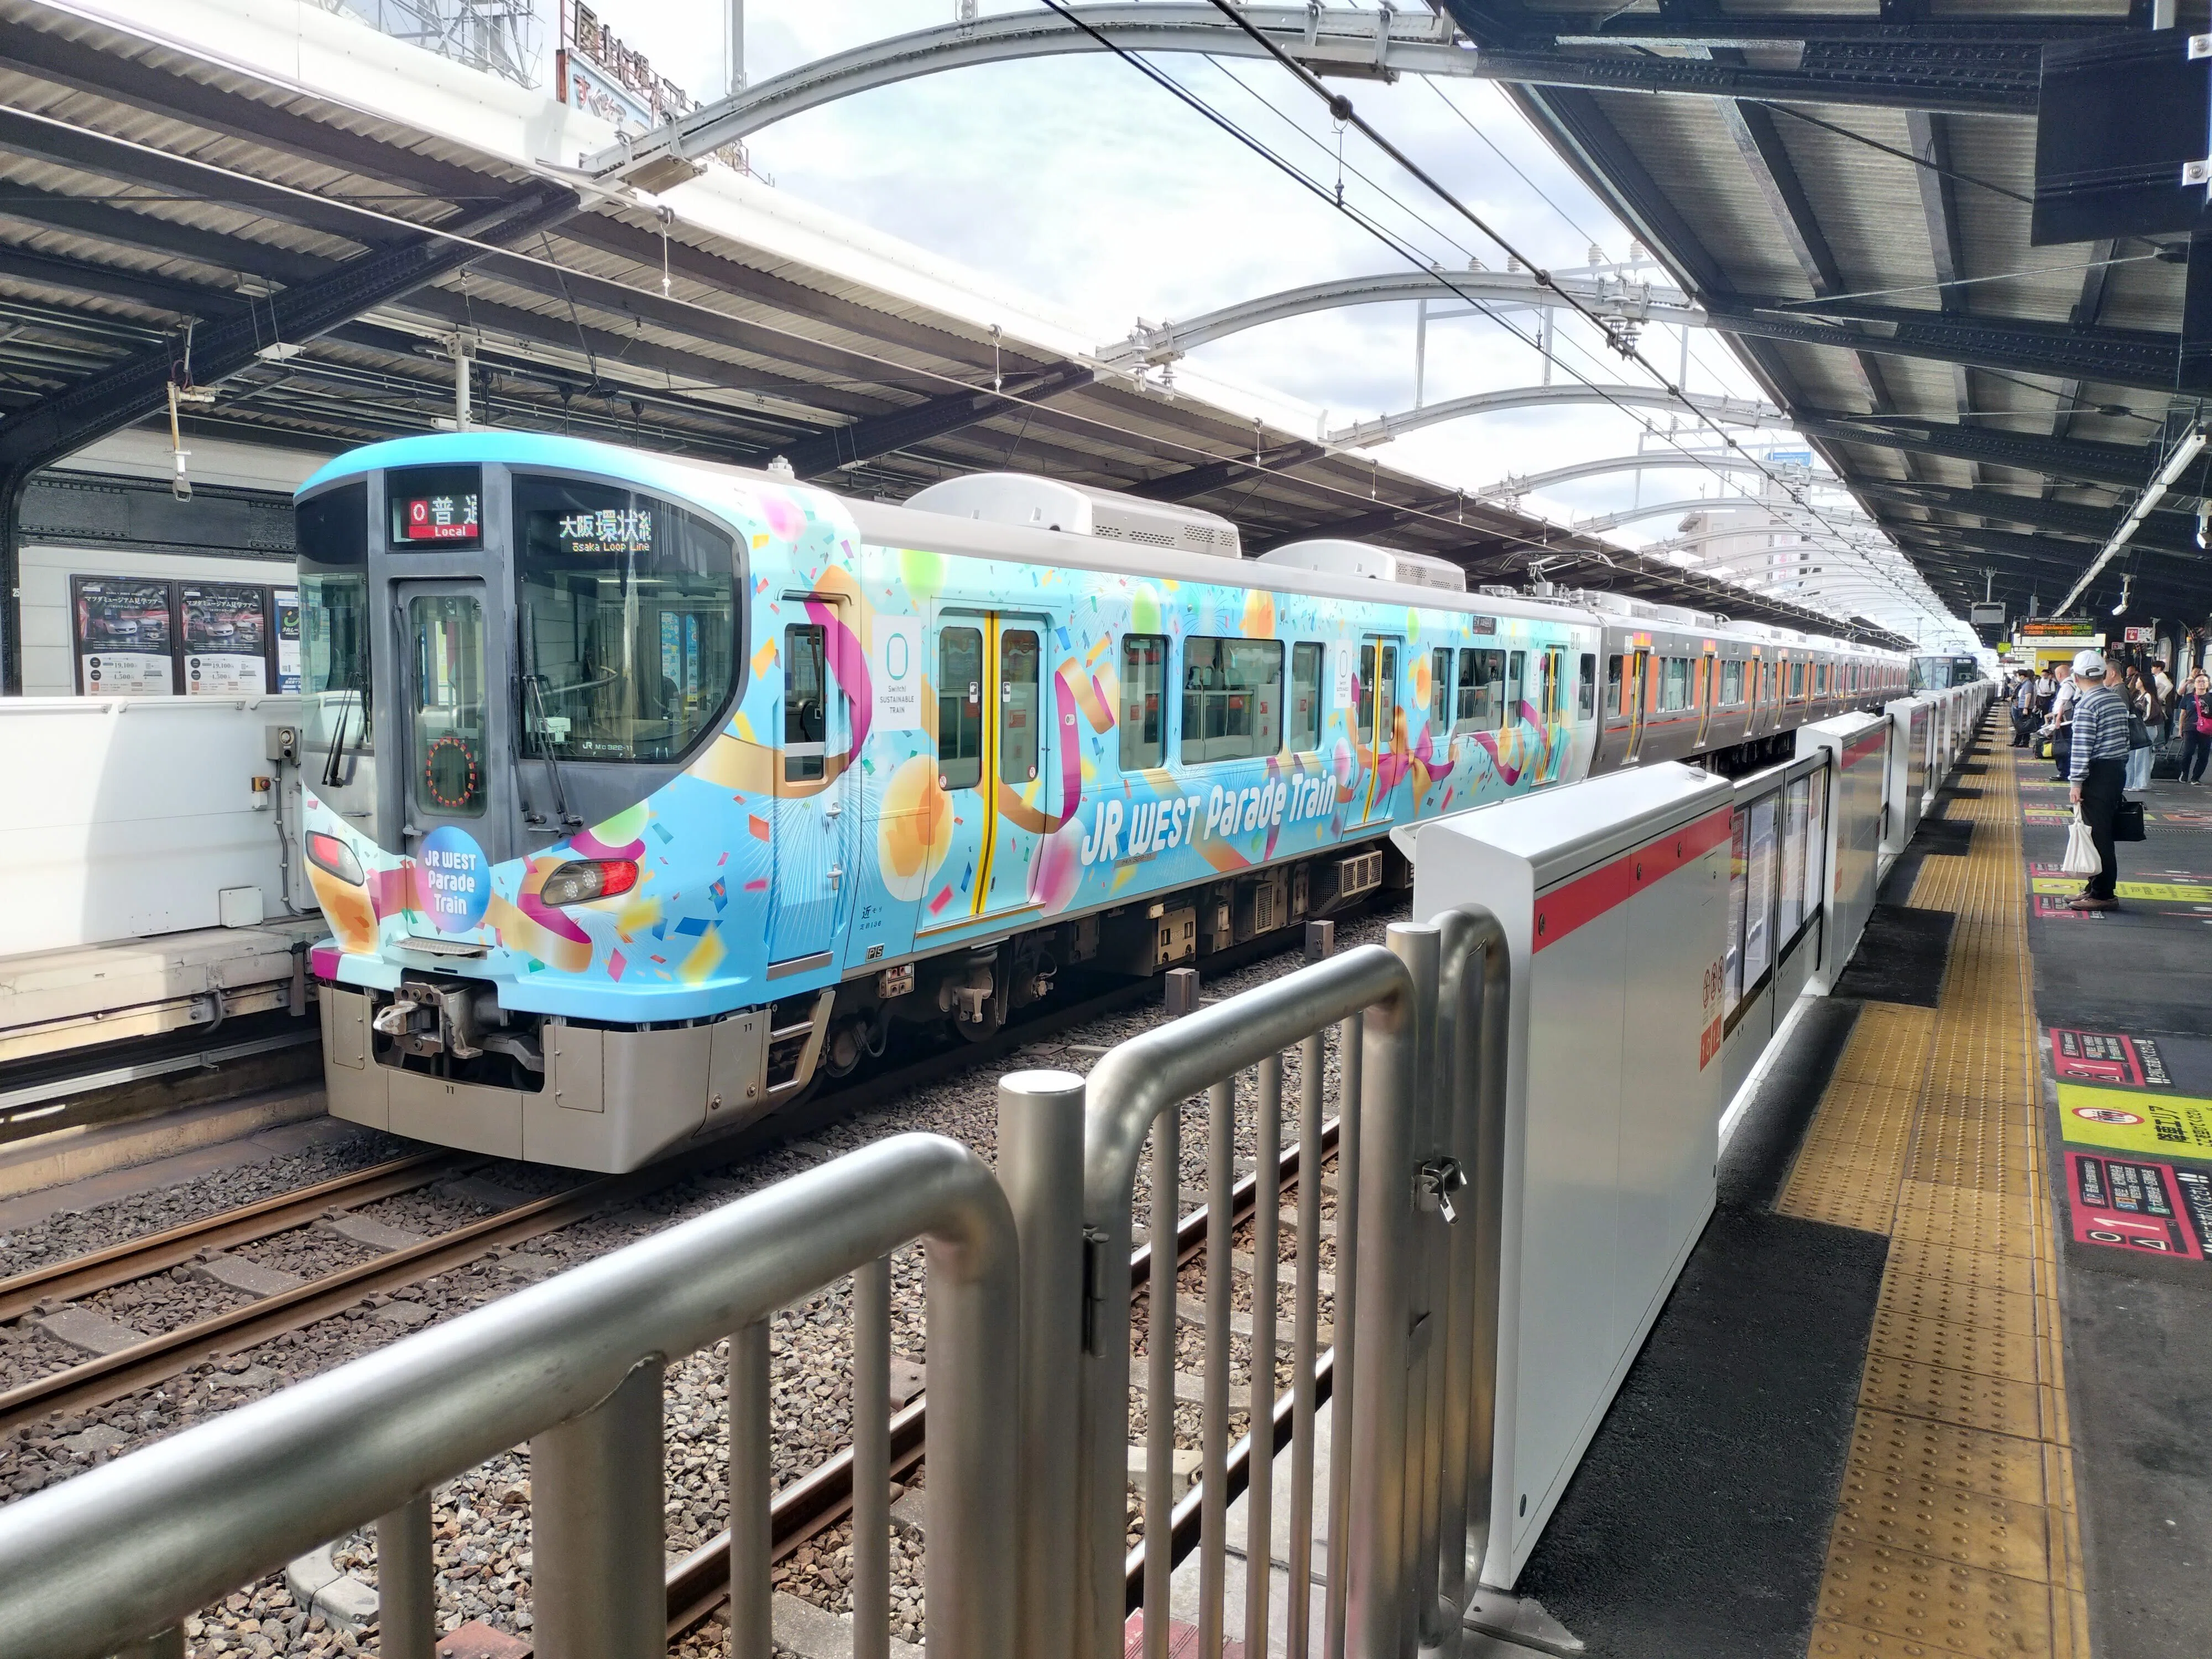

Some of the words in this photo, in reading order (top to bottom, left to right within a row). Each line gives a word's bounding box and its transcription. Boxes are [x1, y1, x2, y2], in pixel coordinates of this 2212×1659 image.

[435, 526, 466, 536] Local
[560, 509, 651, 542] 大阪環状線
[603, 542, 627, 552] Loop
[630, 542, 651, 551] Line
[879, 695, 915, 703] SUSTAINABLE
[582, 742, 593, 750] JR
[1081, 799, 1124, 866] JR
[1127, 795, 1201, 857] WEST
[1203, 776, 1287, 841] Parade
[1288, 769, 1337, 823] Train
[425, 849, 440, 867] JR
[442, 851, 476, 870] WEST
[428, 870, 476, 893] Parade
[434, 893, 467, 915] Train
[2069, 1062, 2117, 1071] 1
[2148, 1105, 2192, 1144] 降車エリア
[2093, 1217, 2161, 1232] 1
